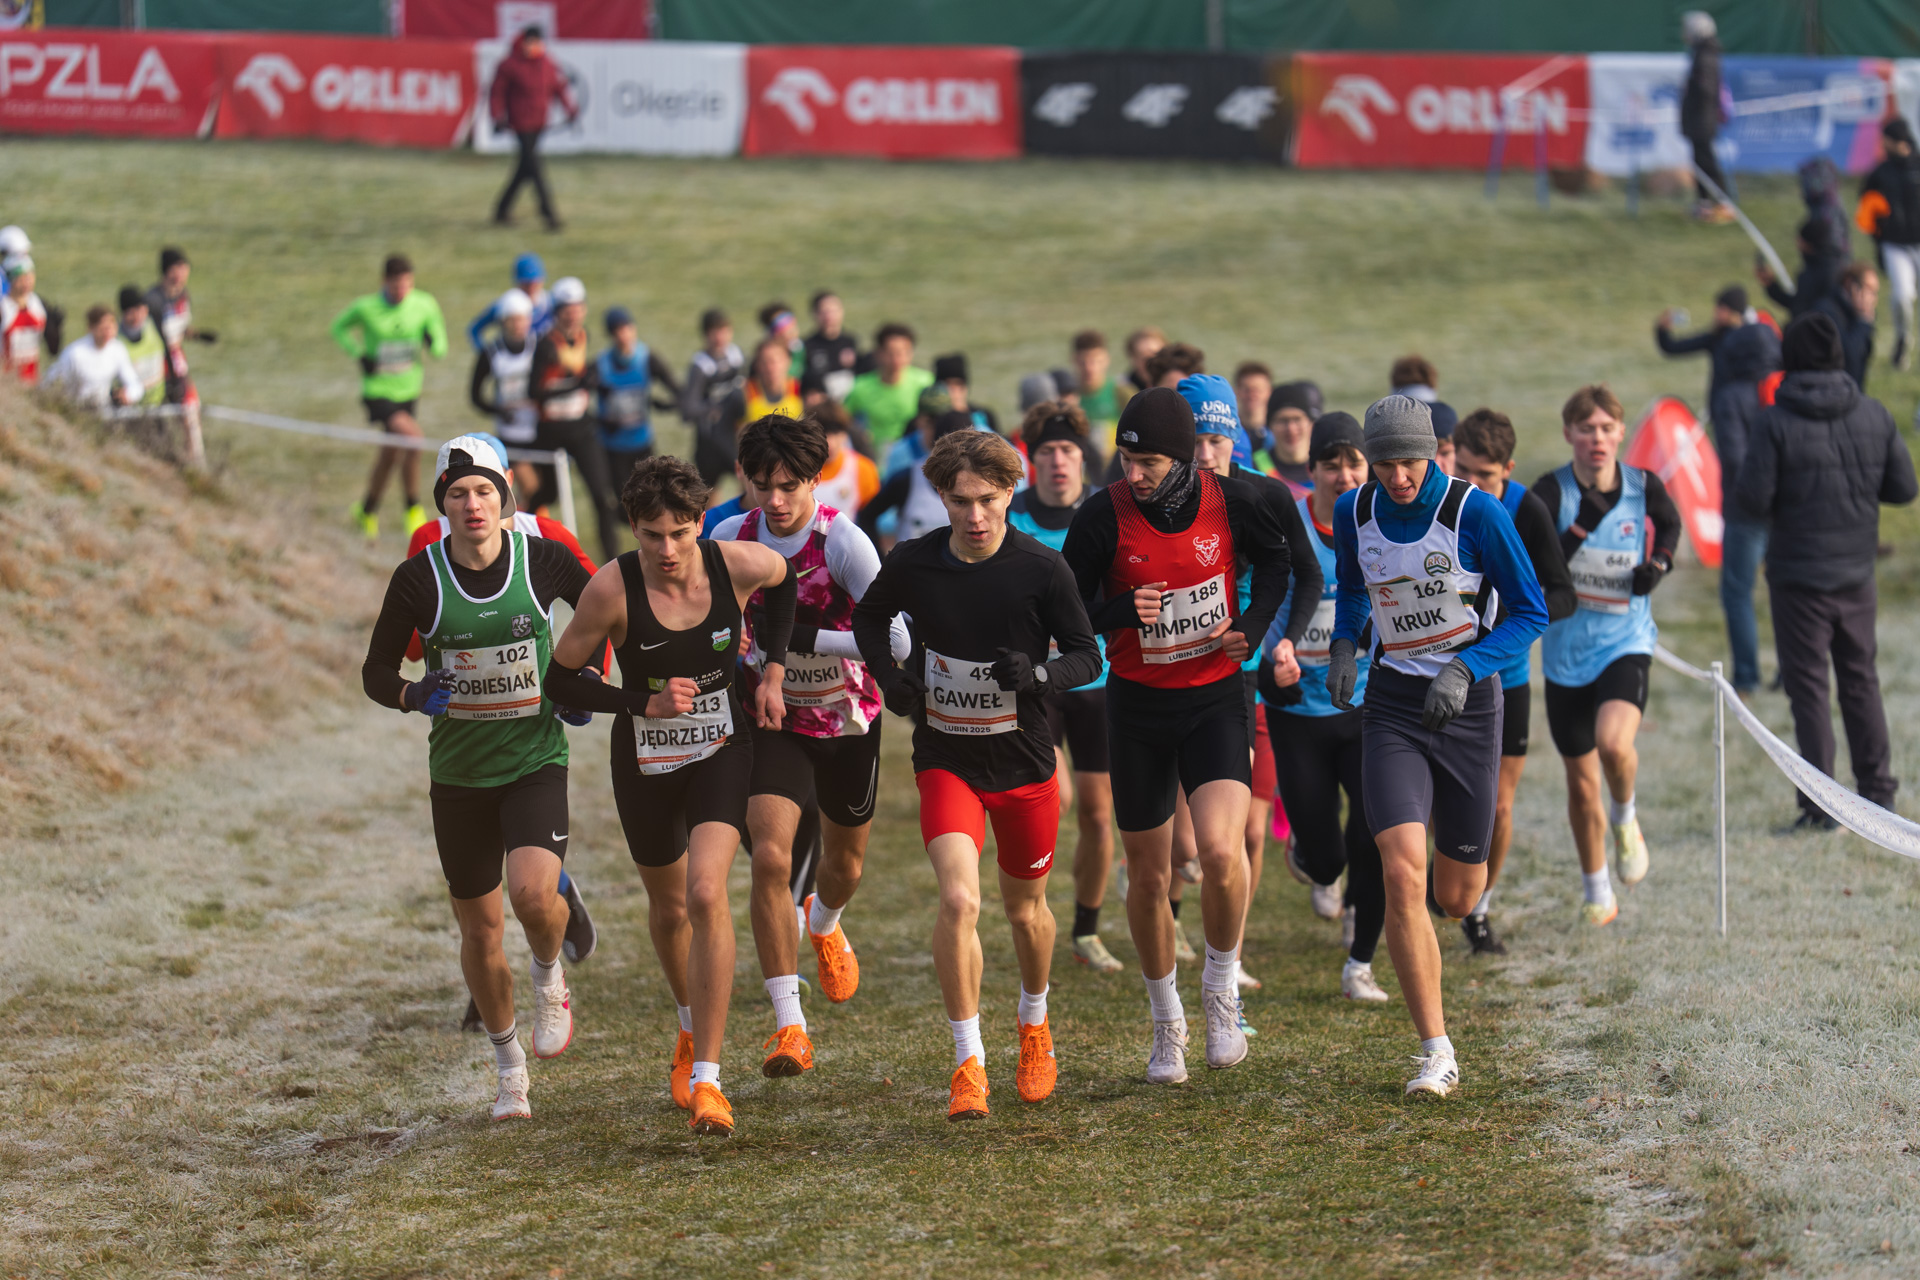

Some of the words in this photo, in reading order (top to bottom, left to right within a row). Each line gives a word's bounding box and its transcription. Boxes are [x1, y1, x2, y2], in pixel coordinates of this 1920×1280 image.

[0, 43, 180, 103] PZLA
[312, 66, 461, 115] ORLEN
[844, 78, 1000, 123] ORLEN
[1033, 82, 1097, 126] 4F
[1122, 83, 1190, 127] 4F
[1407, 86, 1568, 135] ORLEN
[1428, 555, 1447, 566] RKS
[1188, 581, 1218, 605] 188
[1413, 580, 1447, 599] 162
[1142, 602, 1225, 638] PIMPICKI
[1391, 607, 1447, 633] KRUK
[454, 632, 473, 640] UMCS
[1408, 647, 1431, 657] LUBIN
[1431, 640, 1452, 651] 2025
[496, 645, 529, 665] 102
[1168, 650, 1193, 661] LUBIN
[1193, 644, 1213, 655] 2025
[450, 670, 536, 695] SOBIESIAK
[933, 686, 1003, 709] GAWEŁ
[640, 723, 727, 750] JĘDRZEJEK
[1029, 851, 1053, 871] 4F
